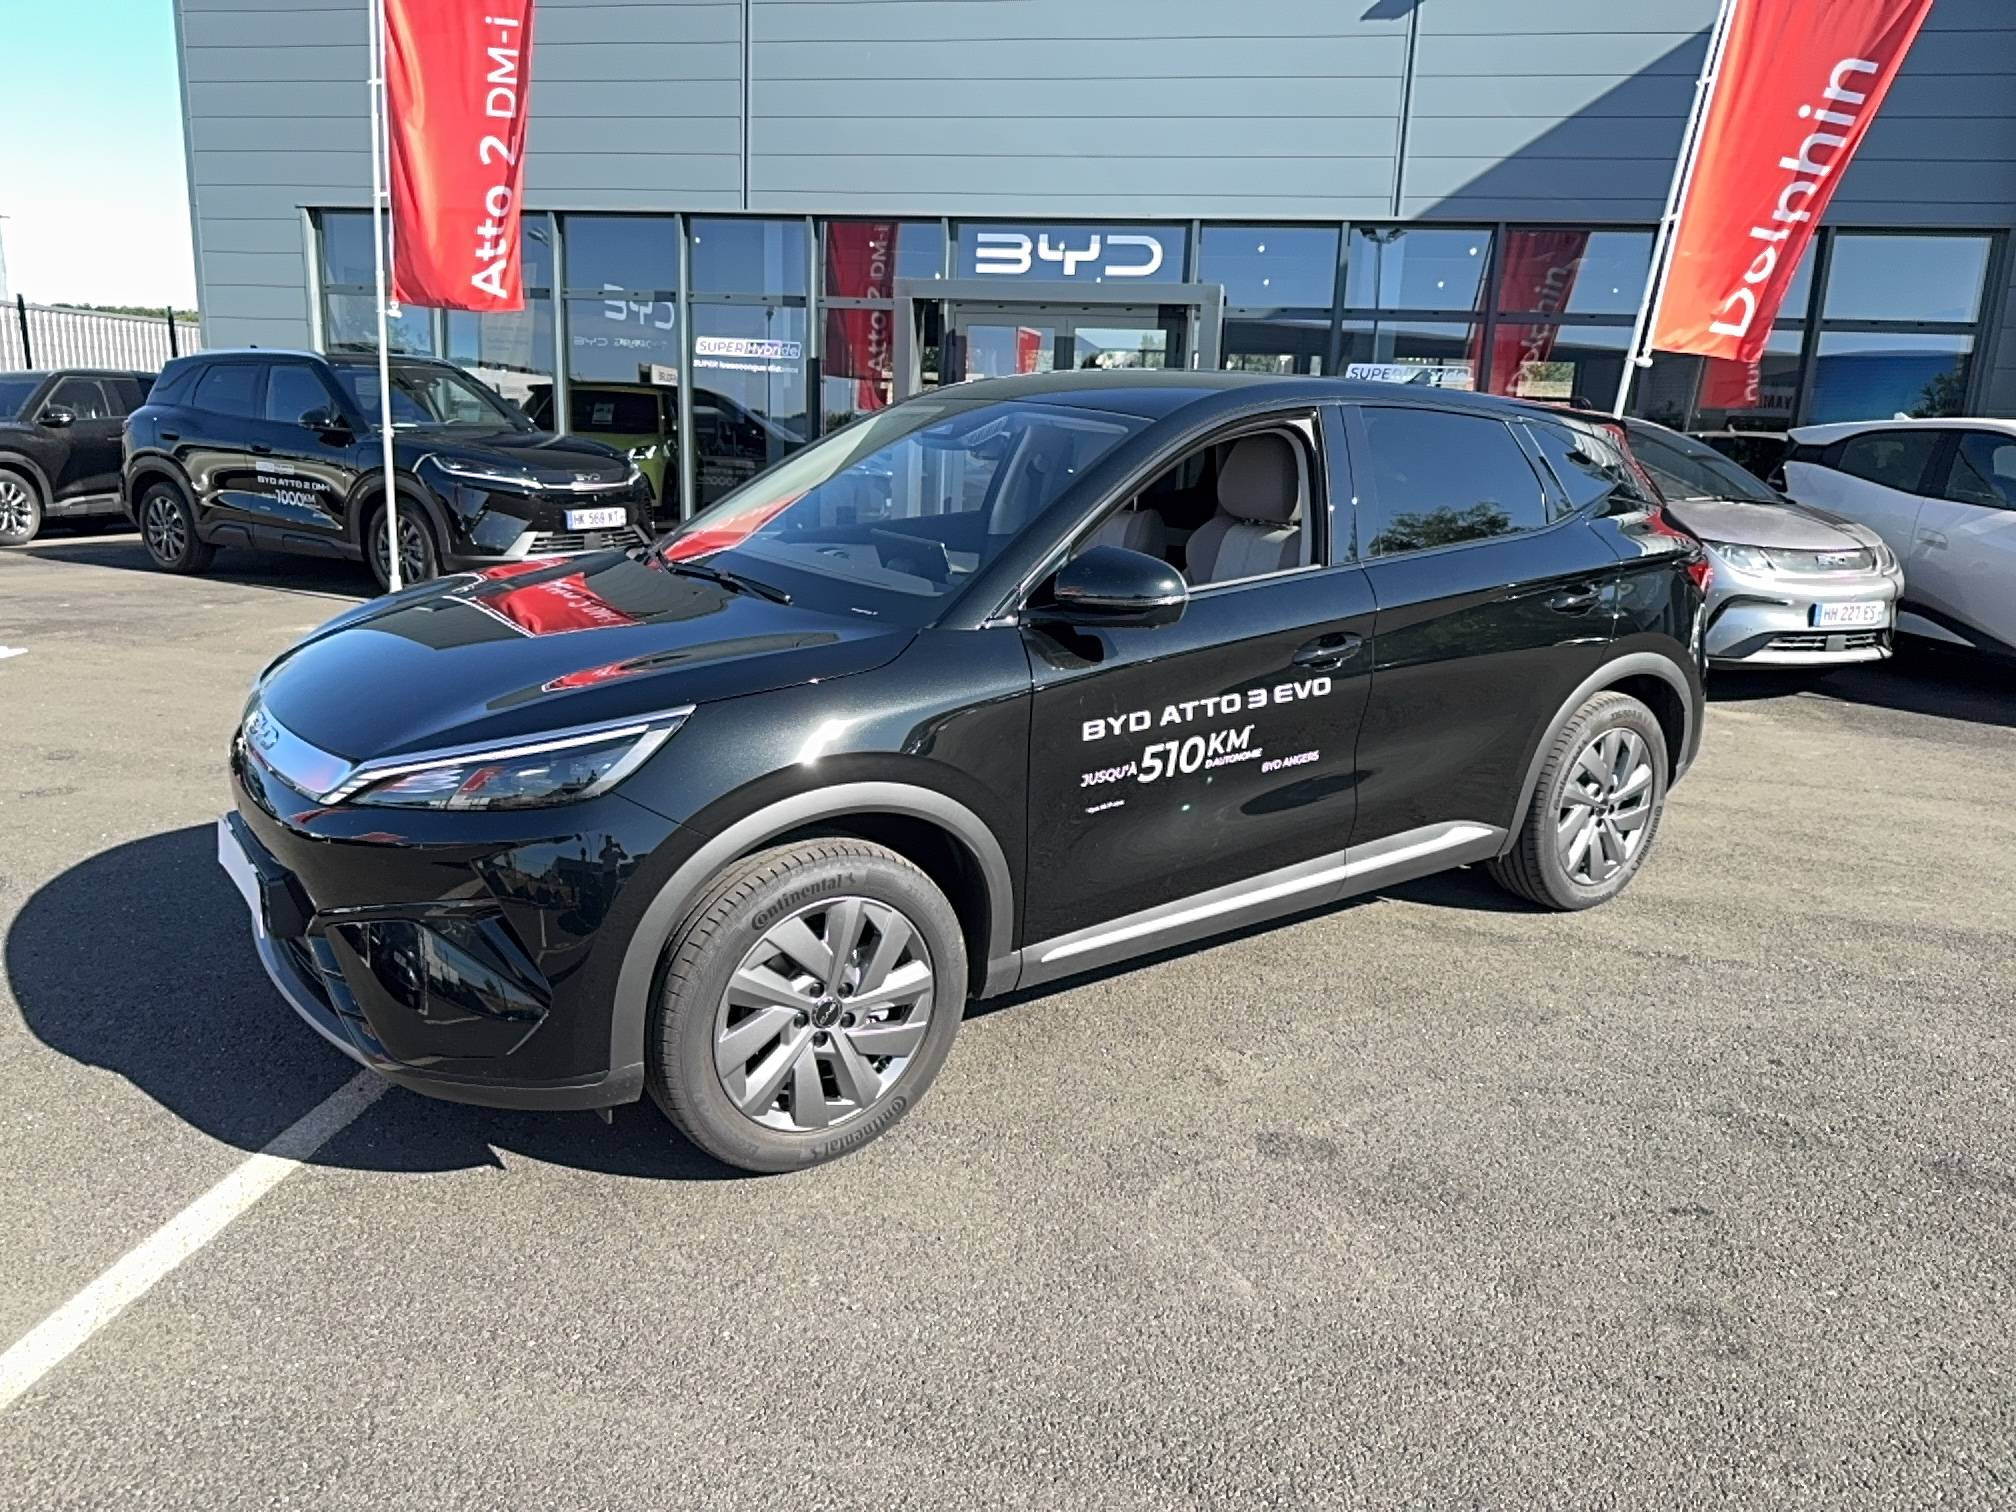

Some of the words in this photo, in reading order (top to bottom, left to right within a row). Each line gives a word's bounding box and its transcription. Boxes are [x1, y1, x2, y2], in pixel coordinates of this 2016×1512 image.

[485, 16, 520, 119] DM-i
[479, 135, 516, 166] 2
[1708, 57, 1879, 338] Dolphin
[471, 184, 513, 299] Atto
[975, 233, 1164, 276] BYD
[603, 283, 675, 331] BYD
[868, 310, 889, 372] Atto
[257, 475, 277, 485] BYD
[278, 478, 303, 489] ATTO
[1082, 711, 1151, 741] BYD
[1159, 693, 1241, 726] ATTO
[1246, 689, 1268, 709] 3
[1274, 677, 1332, 704] EVO
[1262, 759, 1282, 773] BYD
[752, 873, 843, 931] Continental
